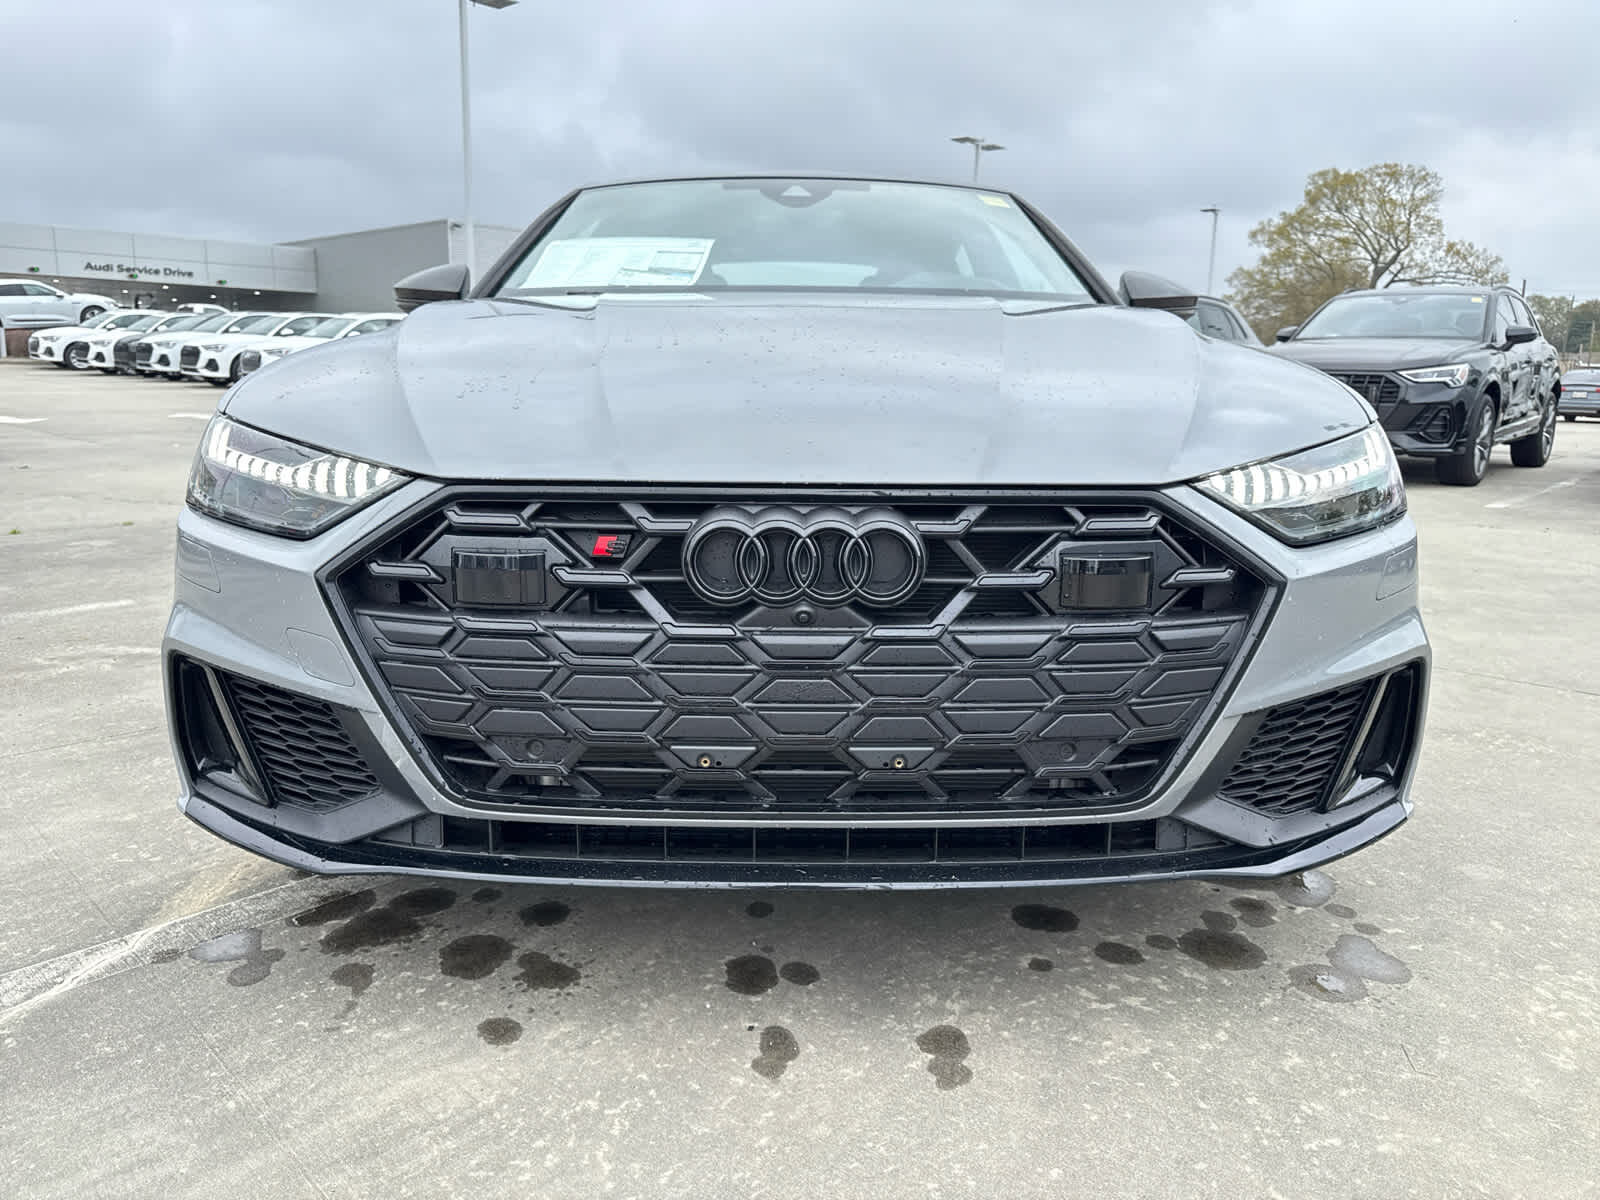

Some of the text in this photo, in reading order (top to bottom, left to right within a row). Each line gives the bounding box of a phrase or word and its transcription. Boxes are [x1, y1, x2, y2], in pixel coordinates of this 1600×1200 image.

[84, 262, 194, 278] Audi Service Drive
